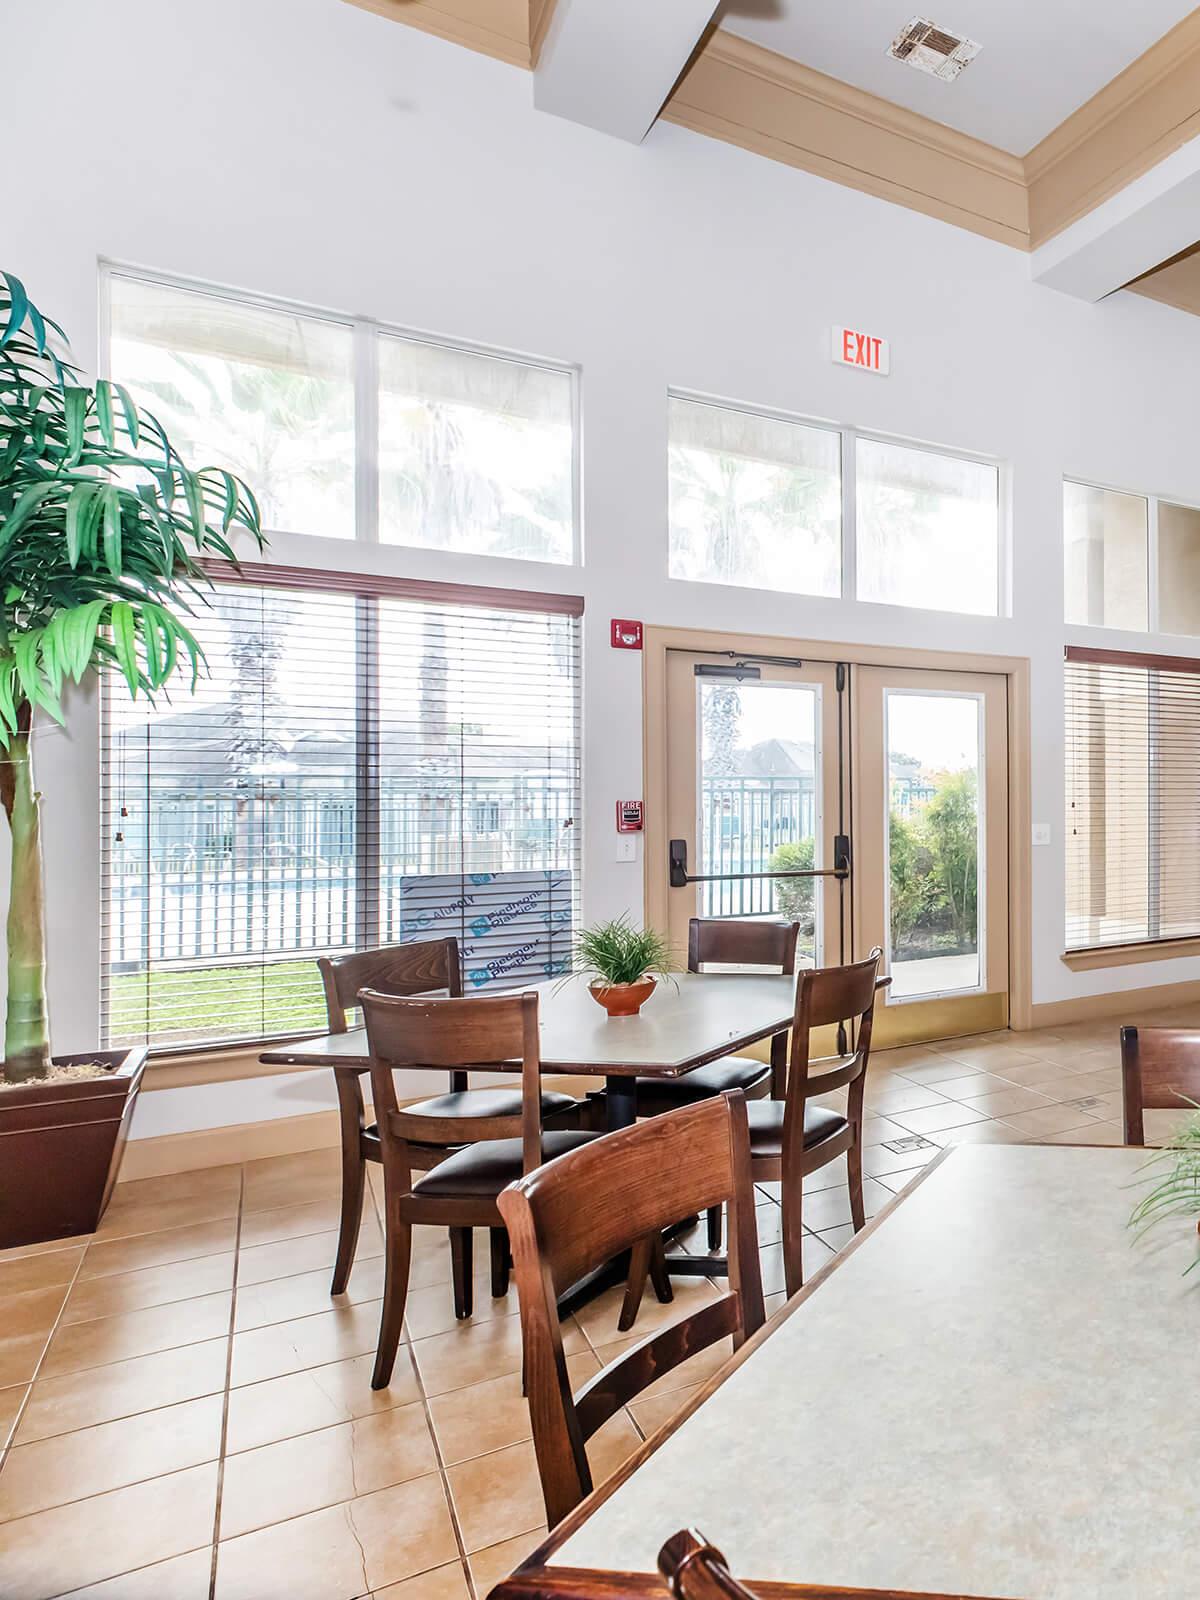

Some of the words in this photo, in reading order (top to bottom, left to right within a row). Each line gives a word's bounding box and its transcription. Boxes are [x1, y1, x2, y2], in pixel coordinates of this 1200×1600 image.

[843, 329, 882, 370] EXIT
[622, 801, 641, 809] FIRE
[487, 890, 543, 920] Piedmont
